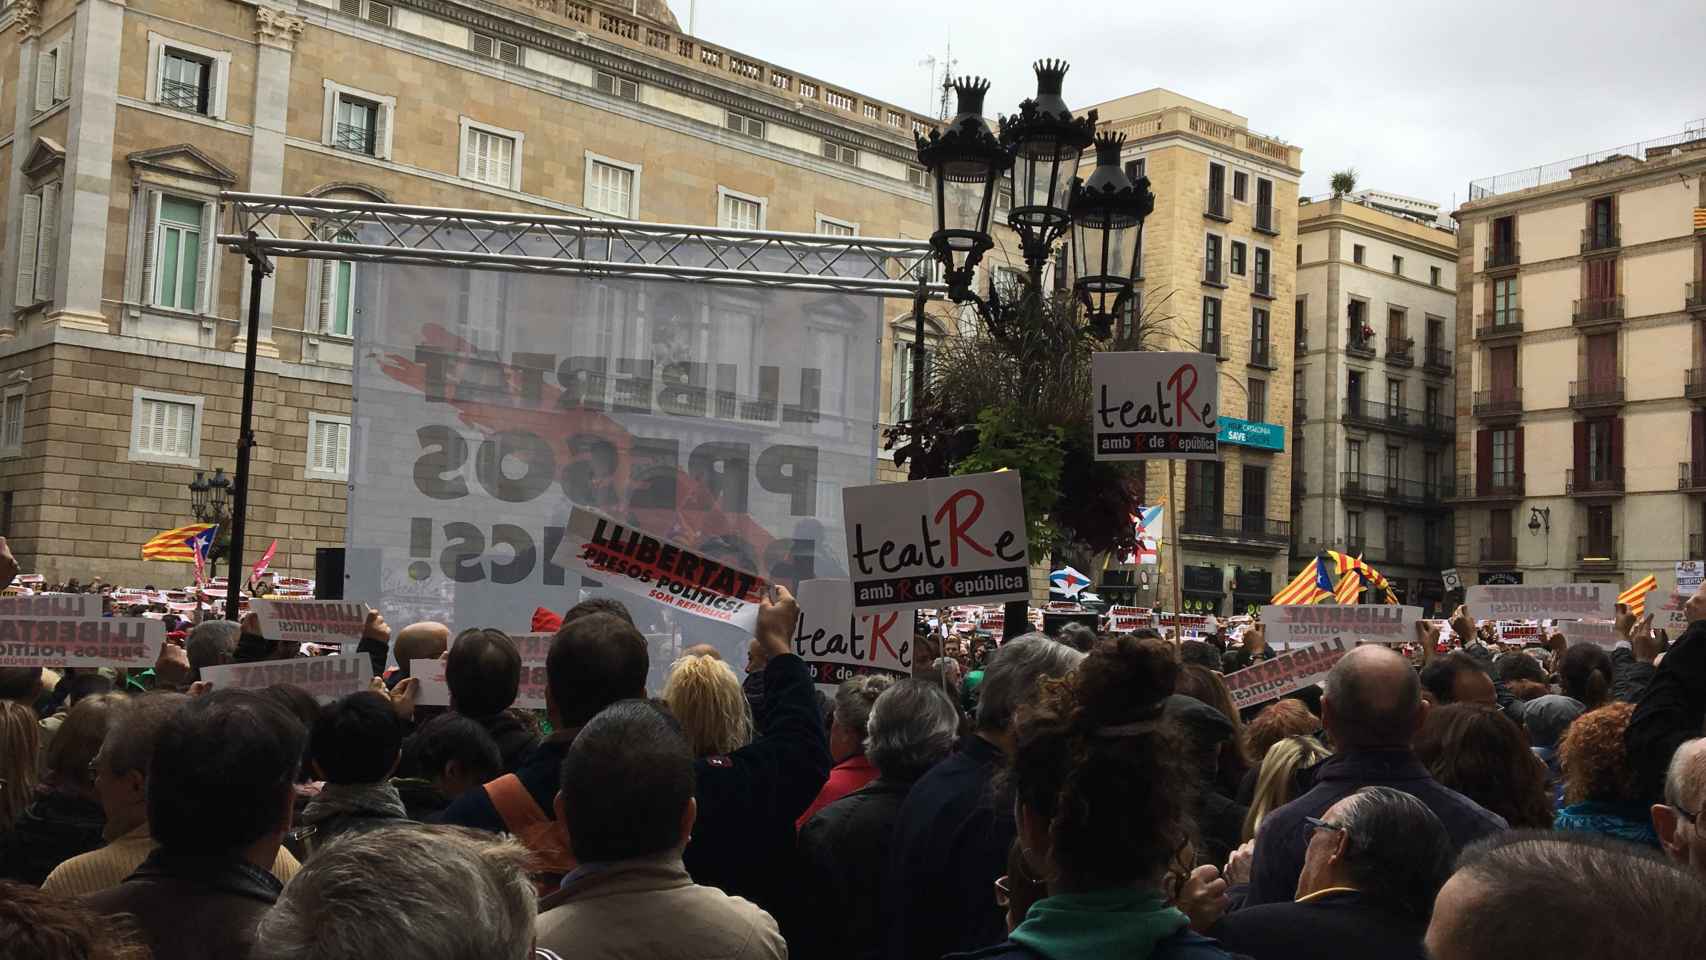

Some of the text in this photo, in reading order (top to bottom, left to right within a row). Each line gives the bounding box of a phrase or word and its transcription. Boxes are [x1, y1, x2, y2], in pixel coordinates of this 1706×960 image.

[1098, 363, 1215, 428] teatRe
[1102, 435, 1131, 449] amb
[1149, 435, 1165, 448] de
[1168, 433, 1215, 452] República
[1228, 430, 1247, 441] SAVE
[853, 489, 1025, 574] teatRe
[592, 518, 758, 599] LLIBERTAT
[648, 589, 674, 604] SOM
[860, 574, 1023, 600] amb R de República
[795, 611, 911, 667] teatRe
